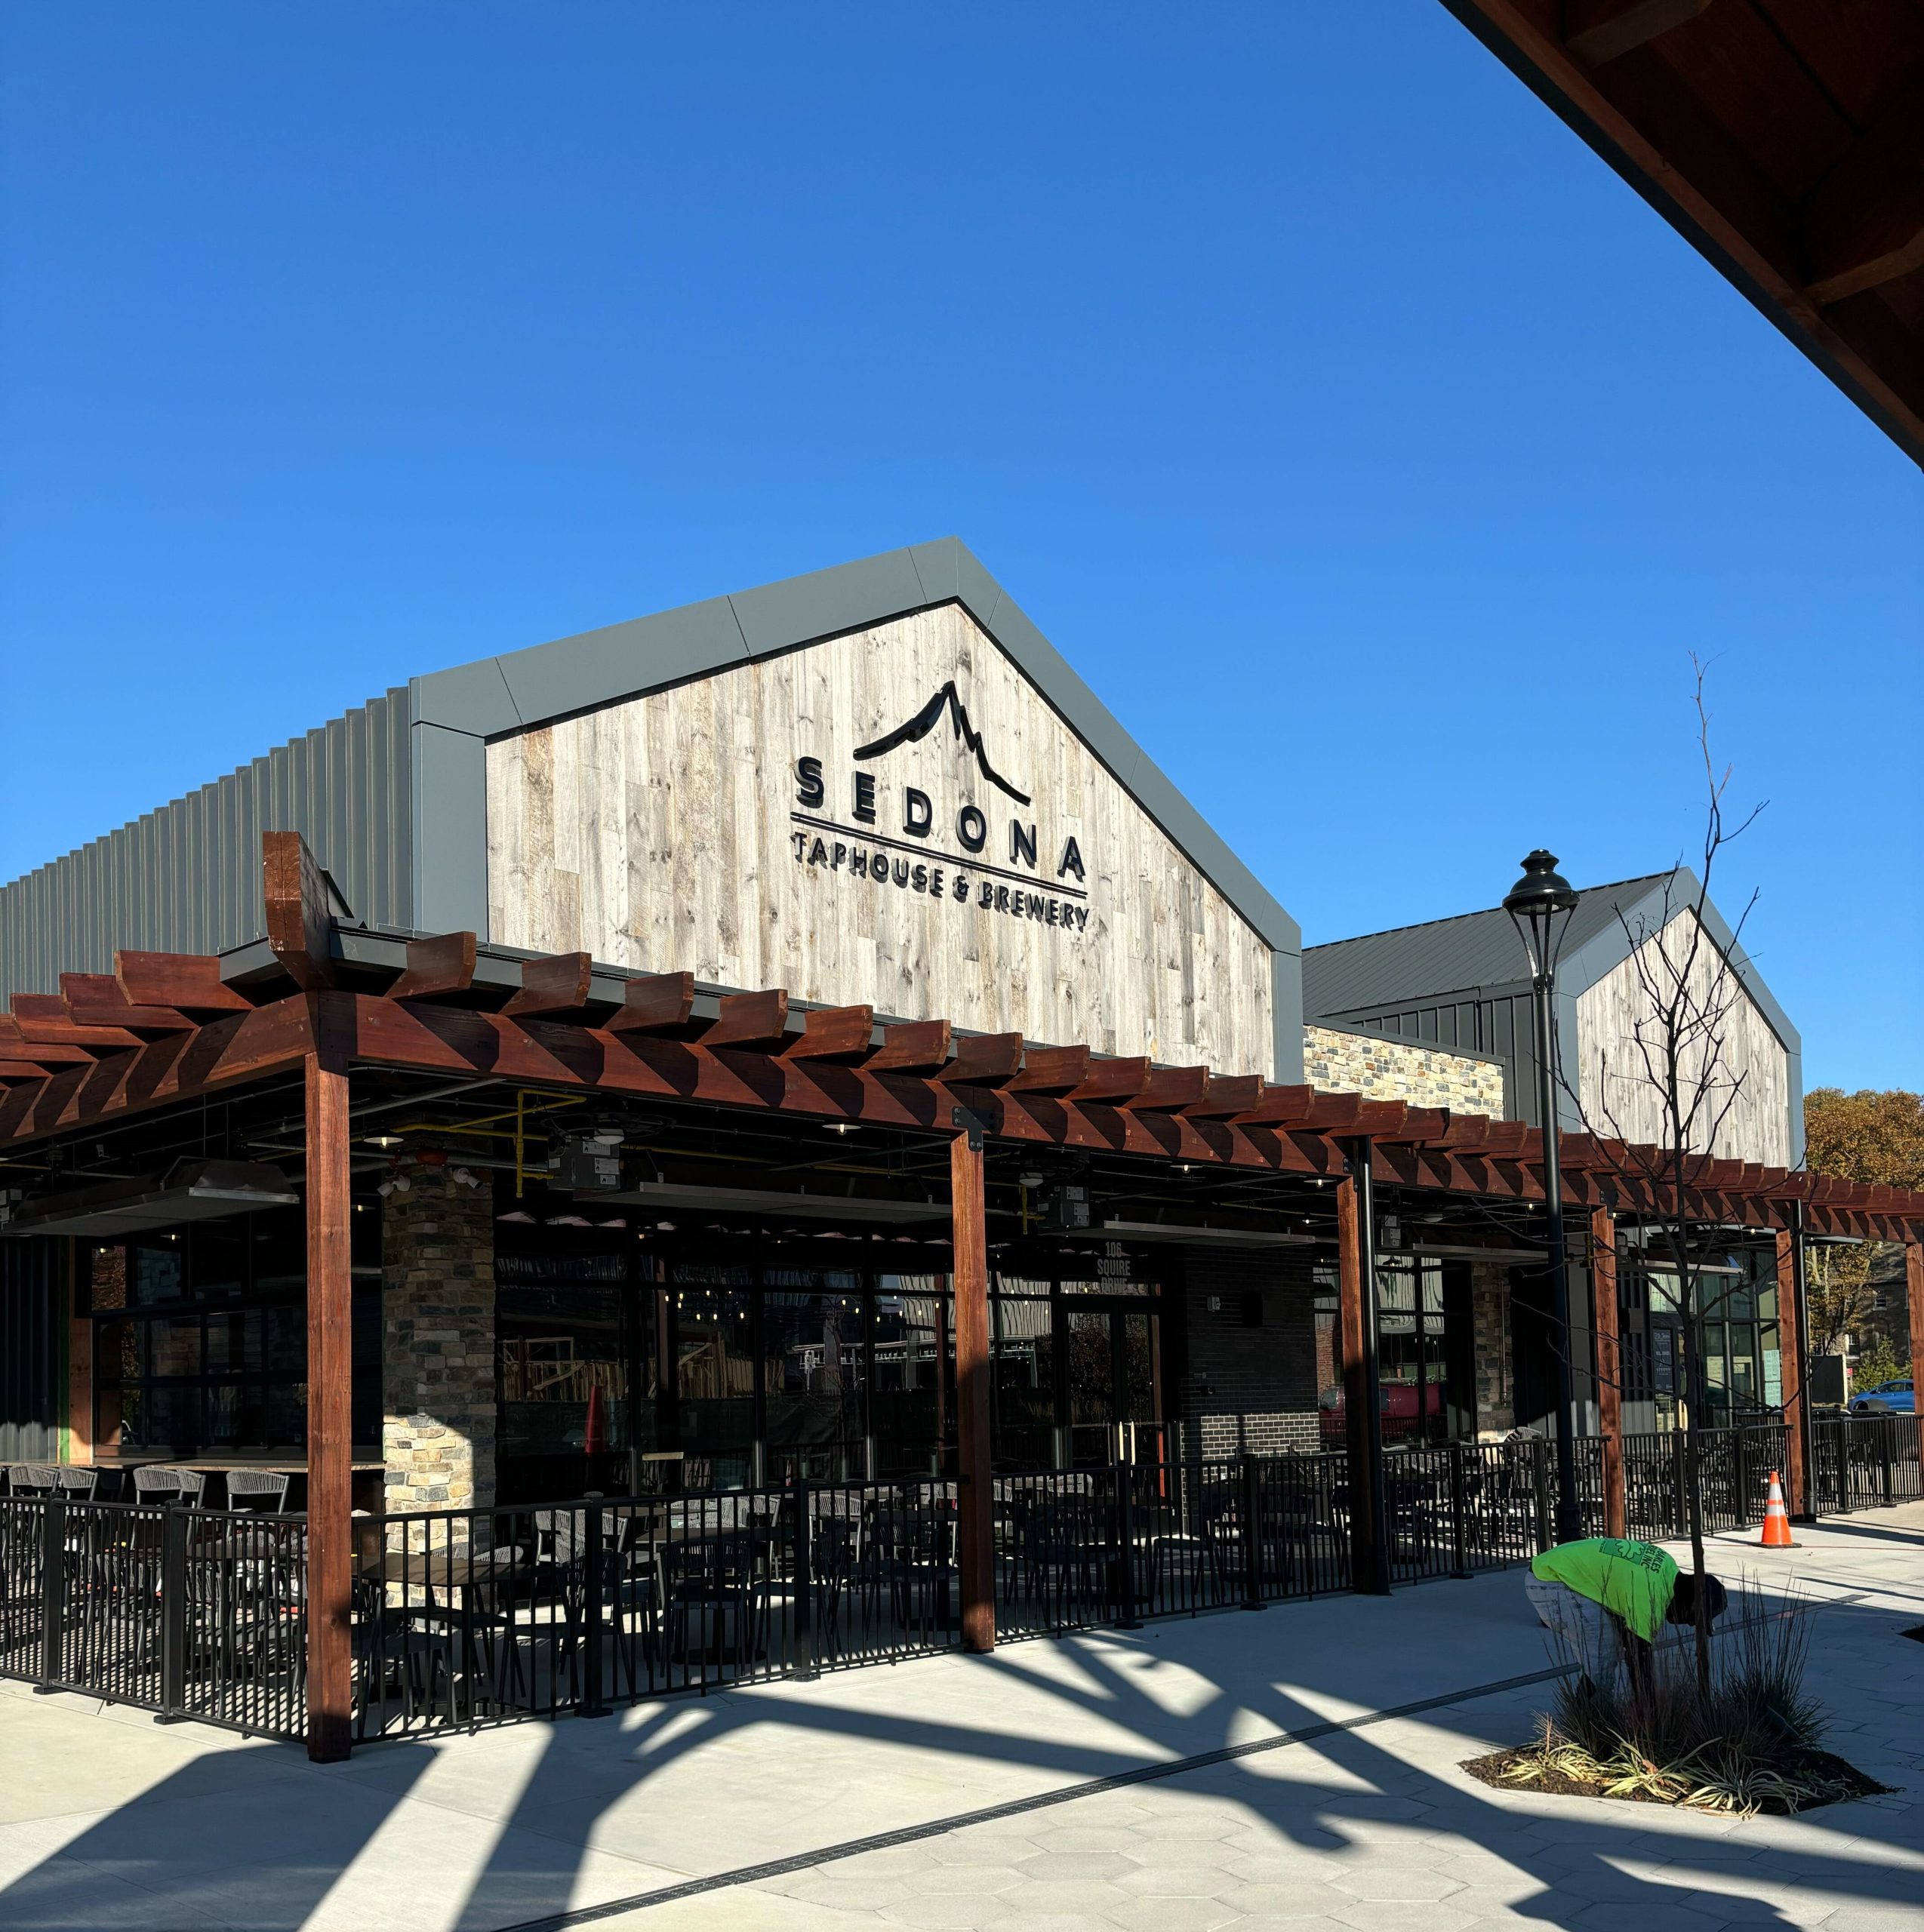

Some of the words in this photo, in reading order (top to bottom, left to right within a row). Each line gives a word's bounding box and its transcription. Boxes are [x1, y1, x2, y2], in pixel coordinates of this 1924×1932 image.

[794, 756, 1085, 881] SEDONA
[790, 832, 944, 897] TAPHOUSE
[953, 875, 968, 902] &
[978, 881, 1089, 932] BREWERY
[1105, 1241, 1122, 1258] 106
[1097, 1258, 1131, 1277] SQUIRE
[1101, 1277, 1127, 1294] DRIVE
[1641, 1554, 1653, 1569] INC
[1651, 1546, 1667, 1574] HARLES
